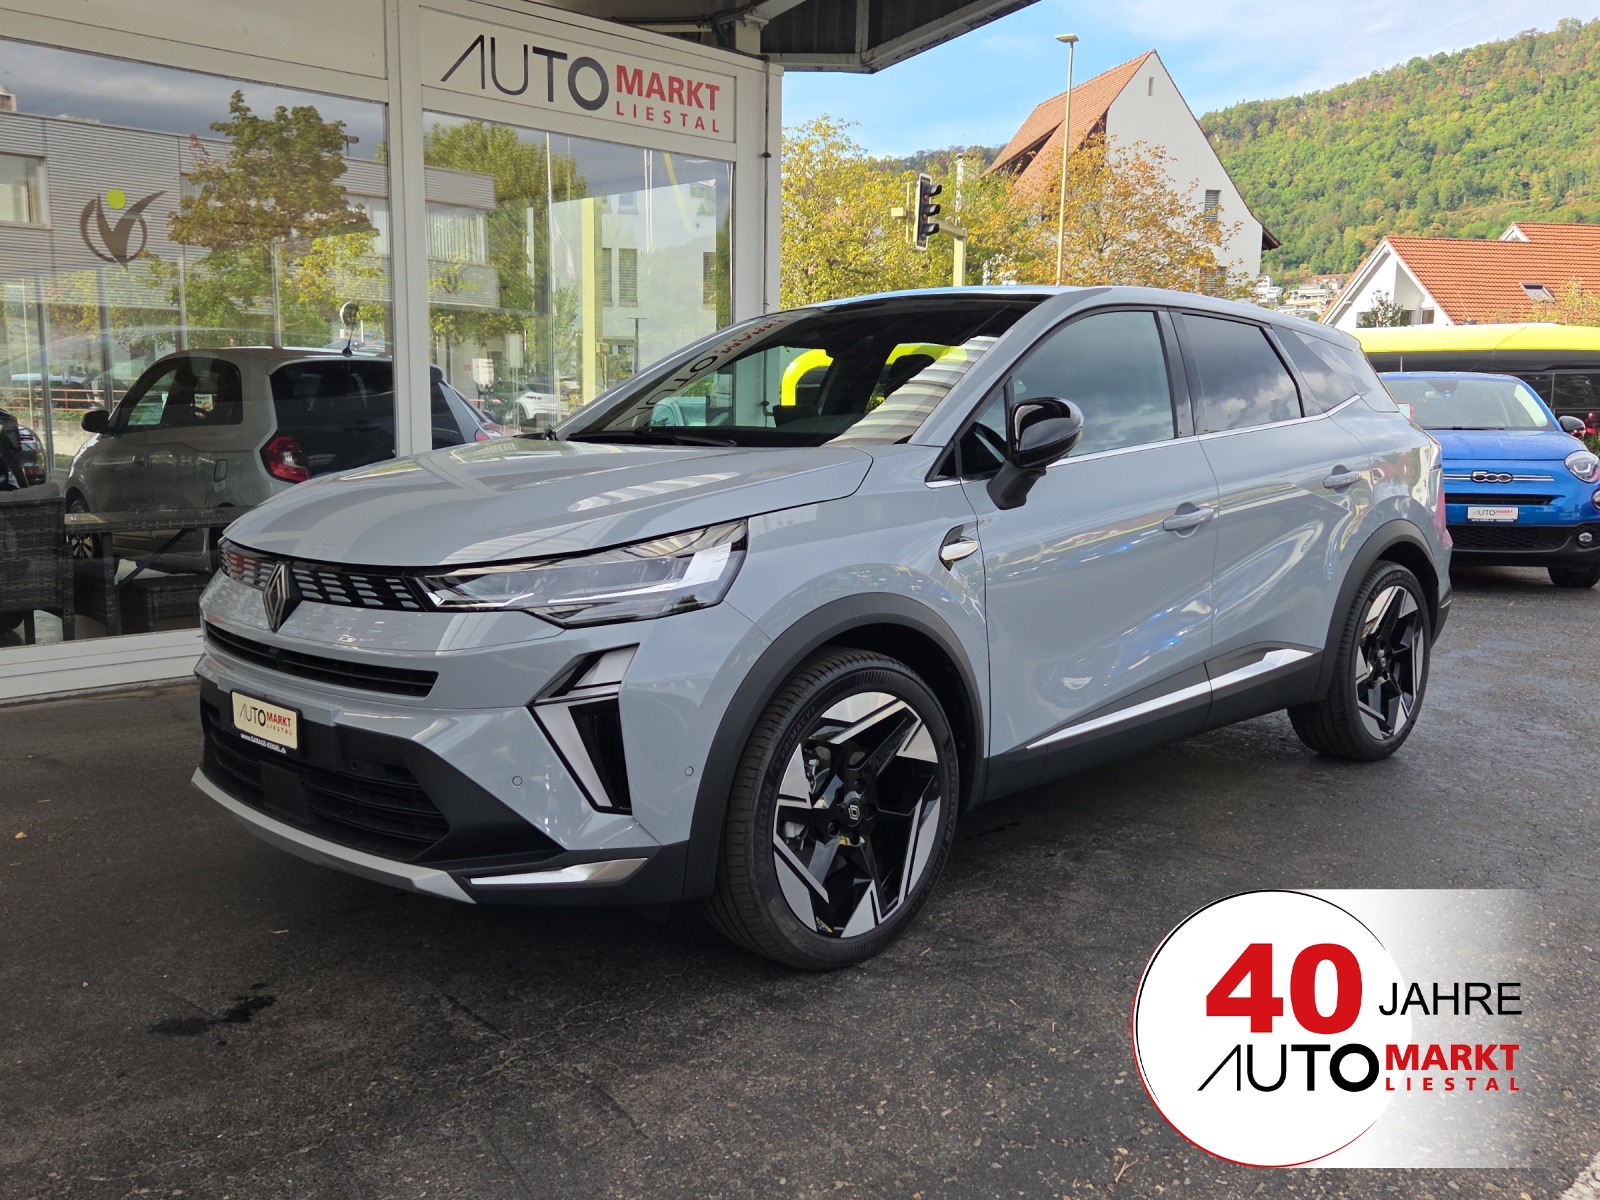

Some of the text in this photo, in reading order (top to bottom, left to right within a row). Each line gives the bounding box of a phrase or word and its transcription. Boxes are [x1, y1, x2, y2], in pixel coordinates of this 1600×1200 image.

[440, 34, 720, 111] AUTO MARKT
[616, 100, 720, 133] LIESTAL
[1472, 470, 1513, 483] 500
[240, 703, 291, 727] AUTO MARKT
[267, 724, 293, 735] LIESTAL
